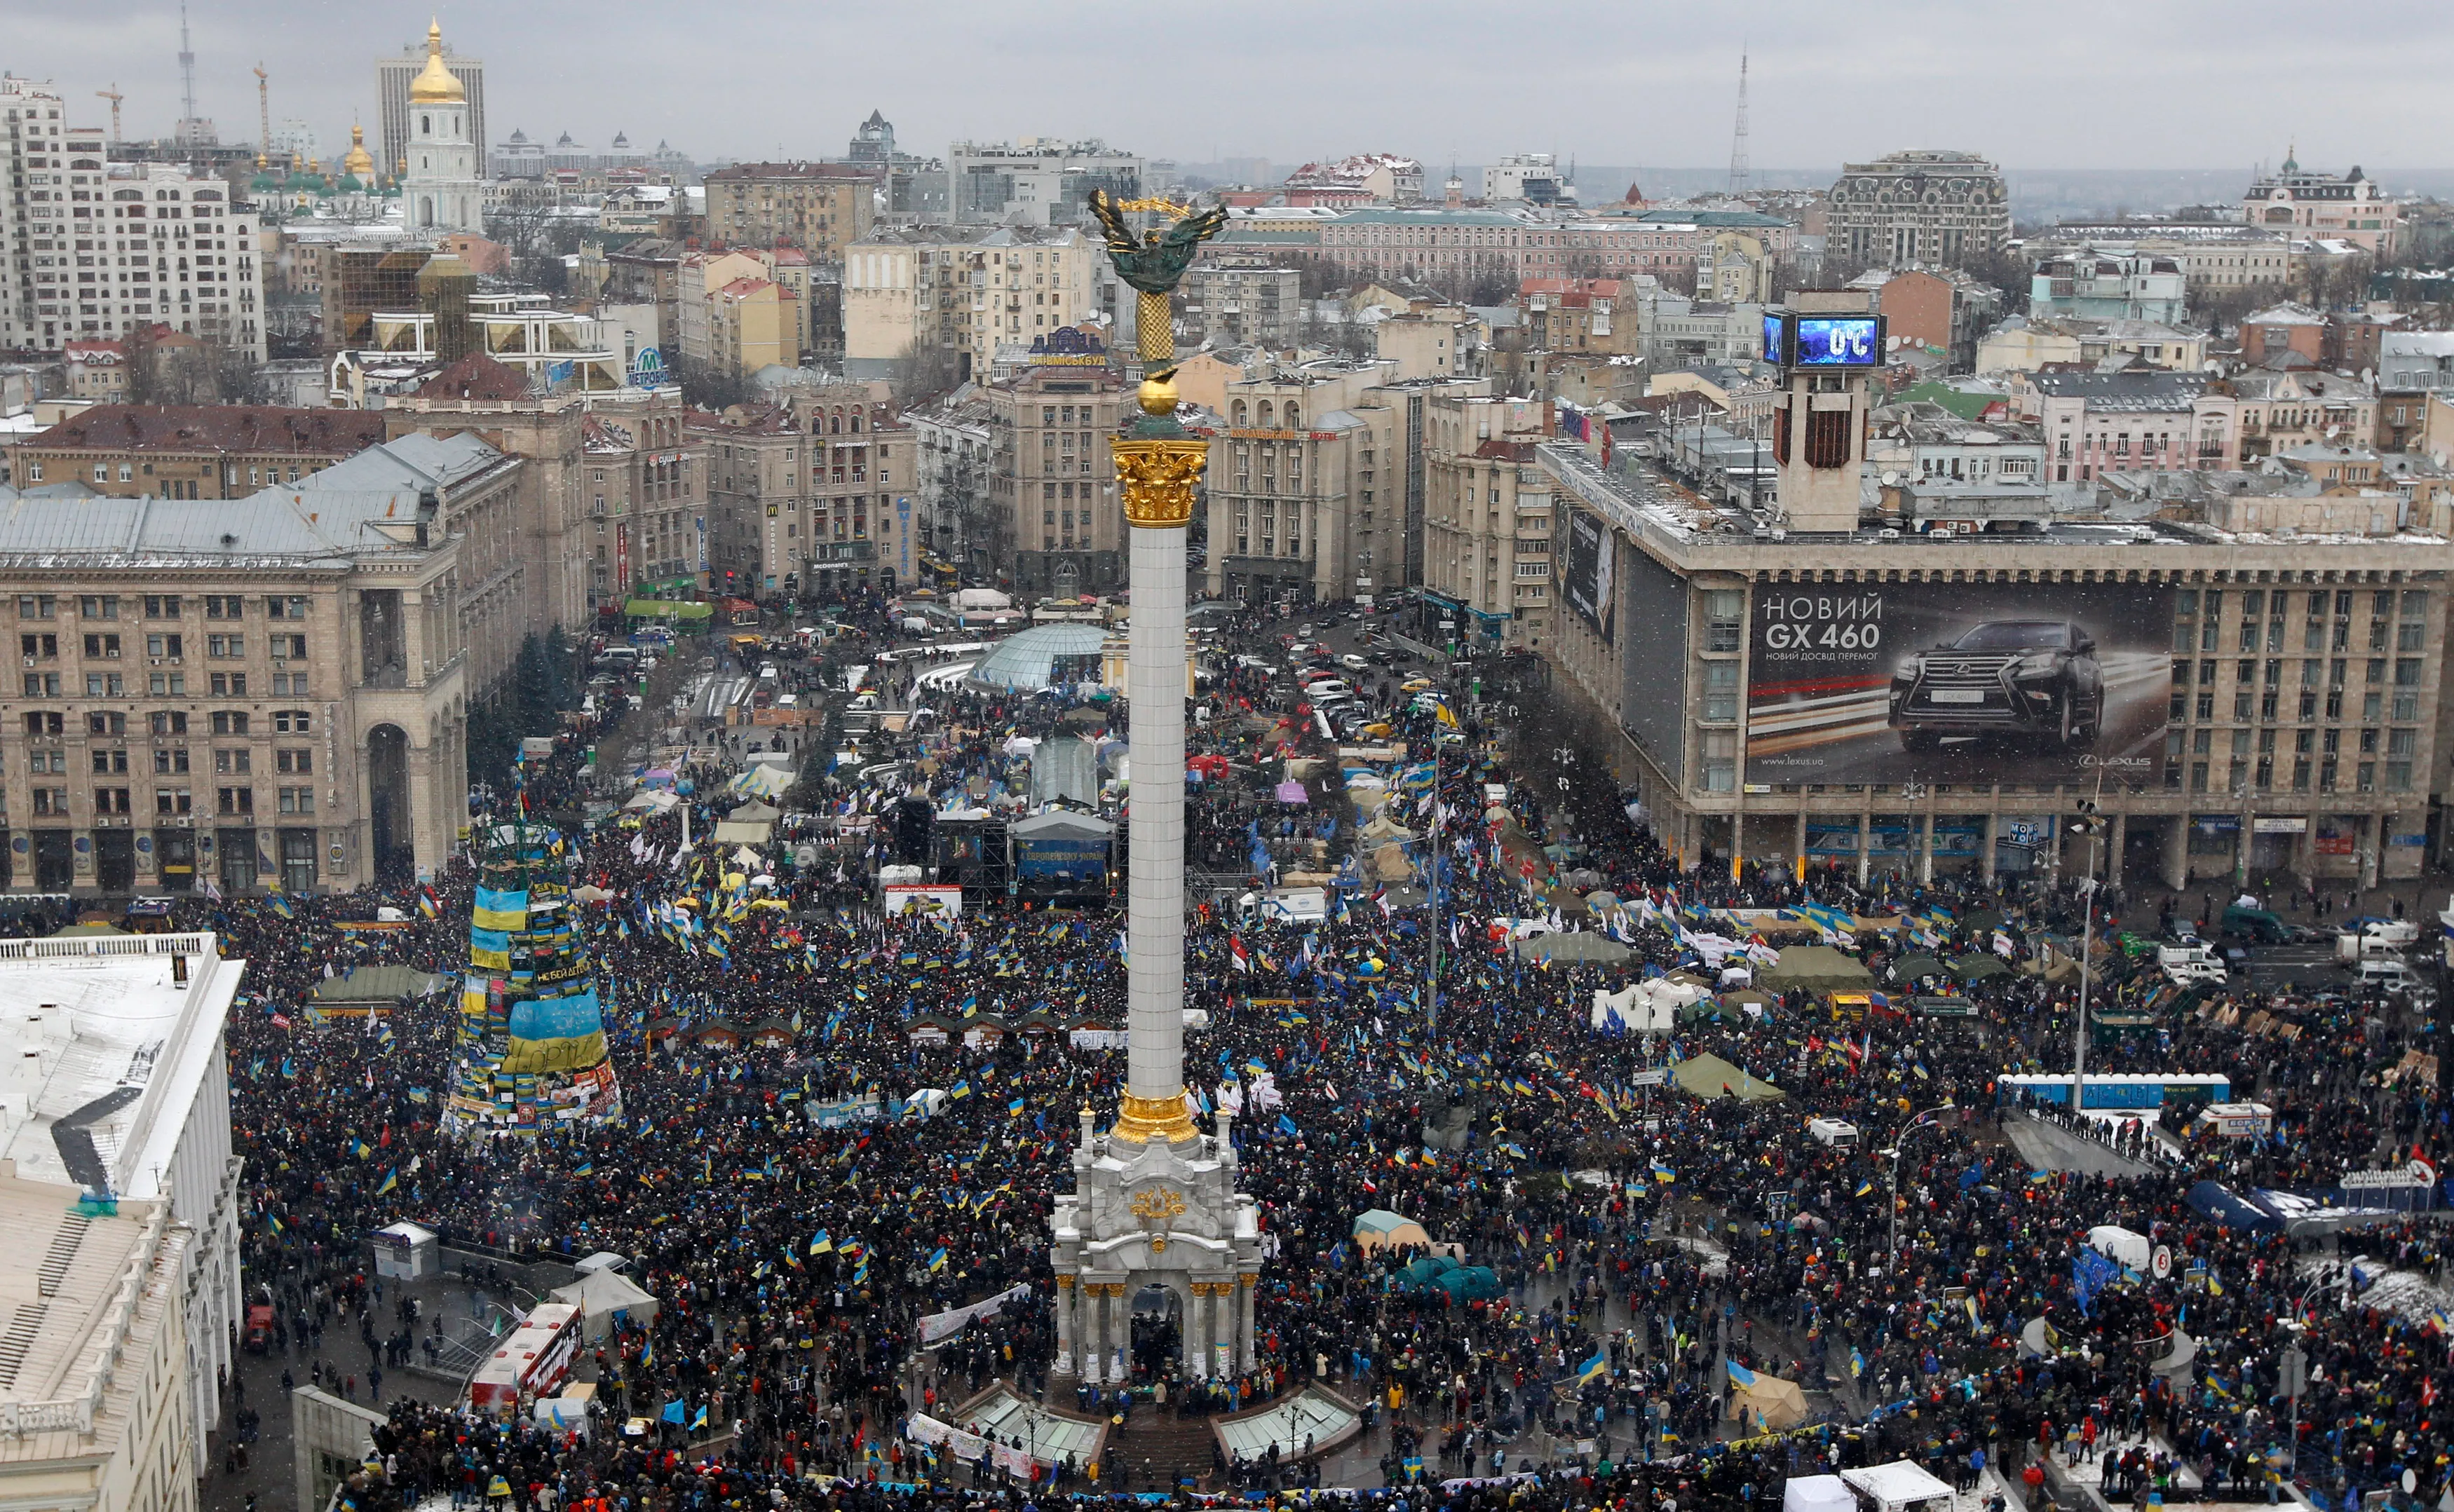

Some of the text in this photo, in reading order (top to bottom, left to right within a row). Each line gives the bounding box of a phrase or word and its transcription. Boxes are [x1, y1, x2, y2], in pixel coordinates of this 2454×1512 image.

[1767, 592, 1882, 620] НОВИЙ
[1765, 623, 1880, 648] GX 460
[1766, 651, 1878, 661] НОВИЙ ДОСВІД ПЕРЕМОГ
[1761, 756, 1824, 766] www.lexus.ua
[538, 974, 550, 982] НЕ
[550, 967, 567, 980] БЕЙ
